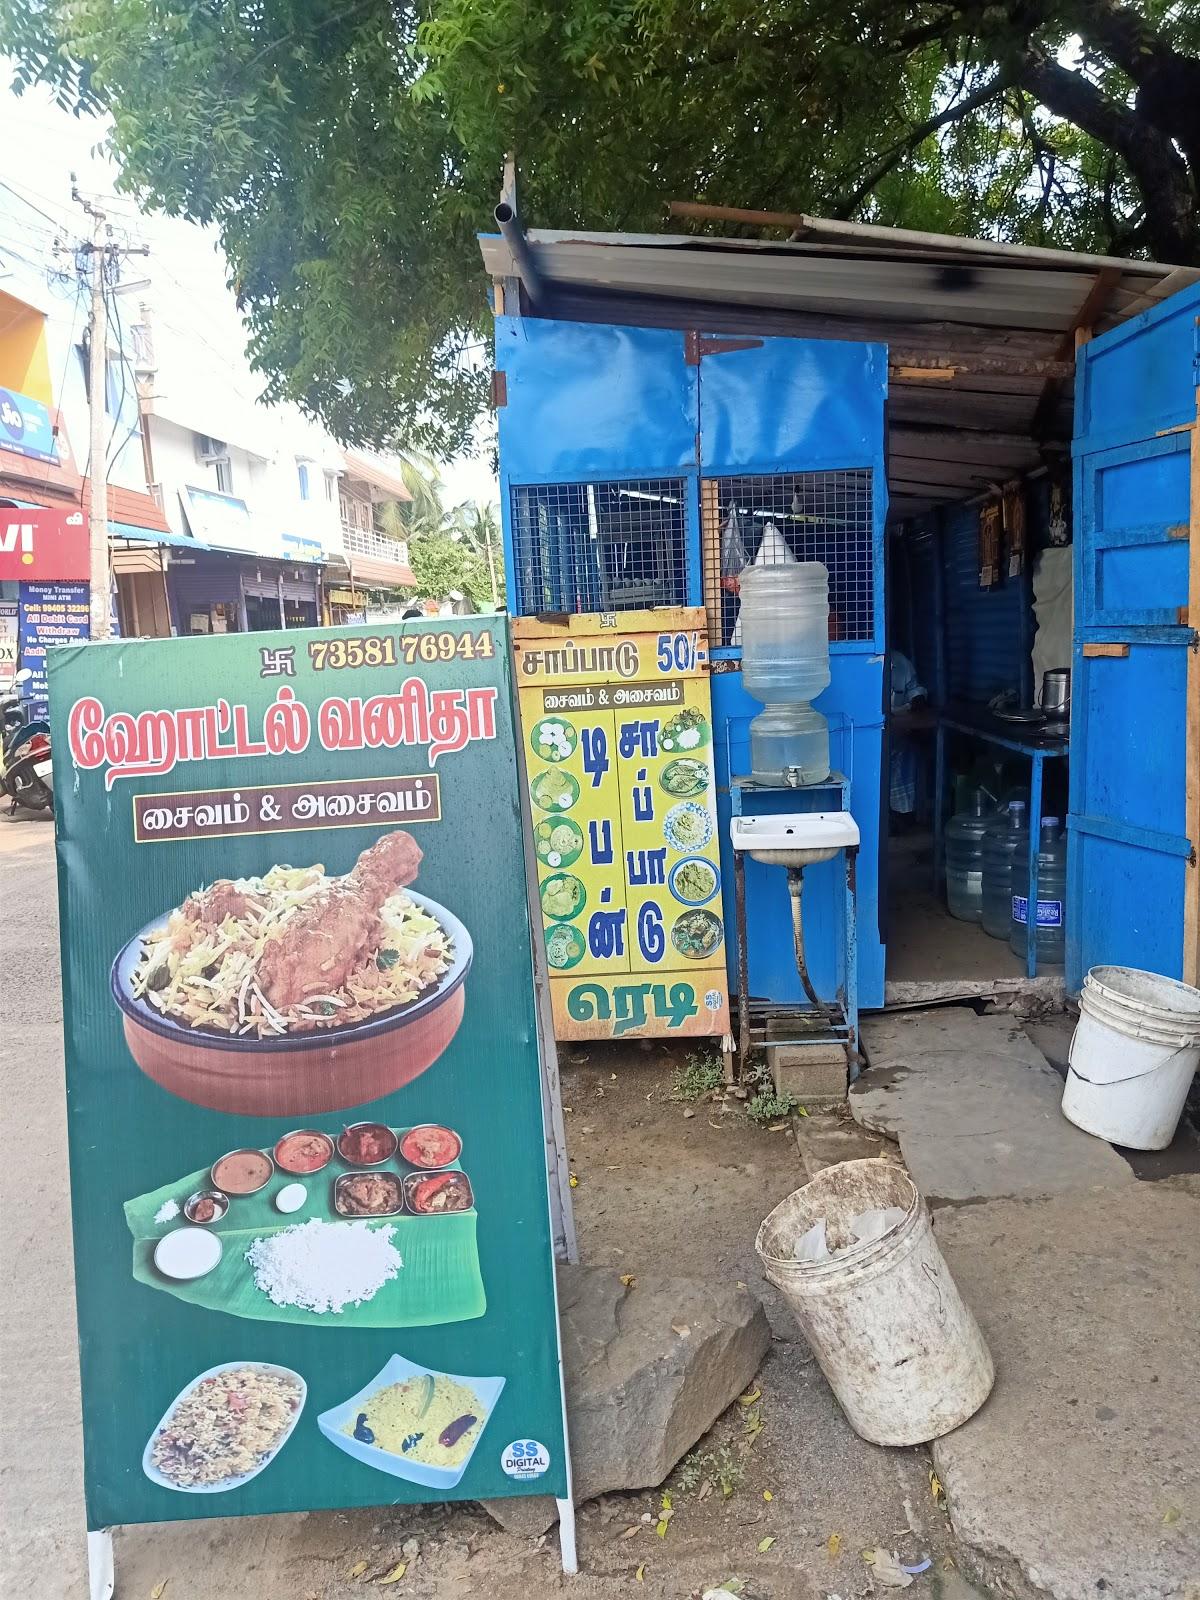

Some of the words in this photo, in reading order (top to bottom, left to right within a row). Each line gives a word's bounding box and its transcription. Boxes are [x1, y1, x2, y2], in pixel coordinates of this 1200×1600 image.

[1, 402, 23, 429] Jio
[28, 586, 52, 594] Money
[54, 586, 85, 594] Transfer
[0, 608, 16, 616] ORLD
[27, 614, 40, 623] All
[41, 614, 66, 623] Debit
[66, 614, 89, 624] Card
[36, 625, 80, 635] Withdraw
[38, 636, 67, 645] Charges
[309, 637, 396, 670] 73581
[400, 632, 494, 664] 76944
[521, 640, 639, 678] சாப்பாடு
[656, 632, 706, 673] 50/-
[544, 687, 595, 709] சைவம்
[598, 688, 609, 705] &
[613, 681, 680, 704] அசைவம்
[68, 685, 311, 791] ஹோட்டல்
[318, 677, 497, 768] வனிதா
[142, 793, 250, 830] சைவம்
[259, 794, 282, 821] &
[291, 779, 432, 819] அசைவம்
[566, 982, 699, 1035] ரெடி
[512, 1441, 538, 1458] SS
[505, 1457, 546, 1468] DIGITAL
